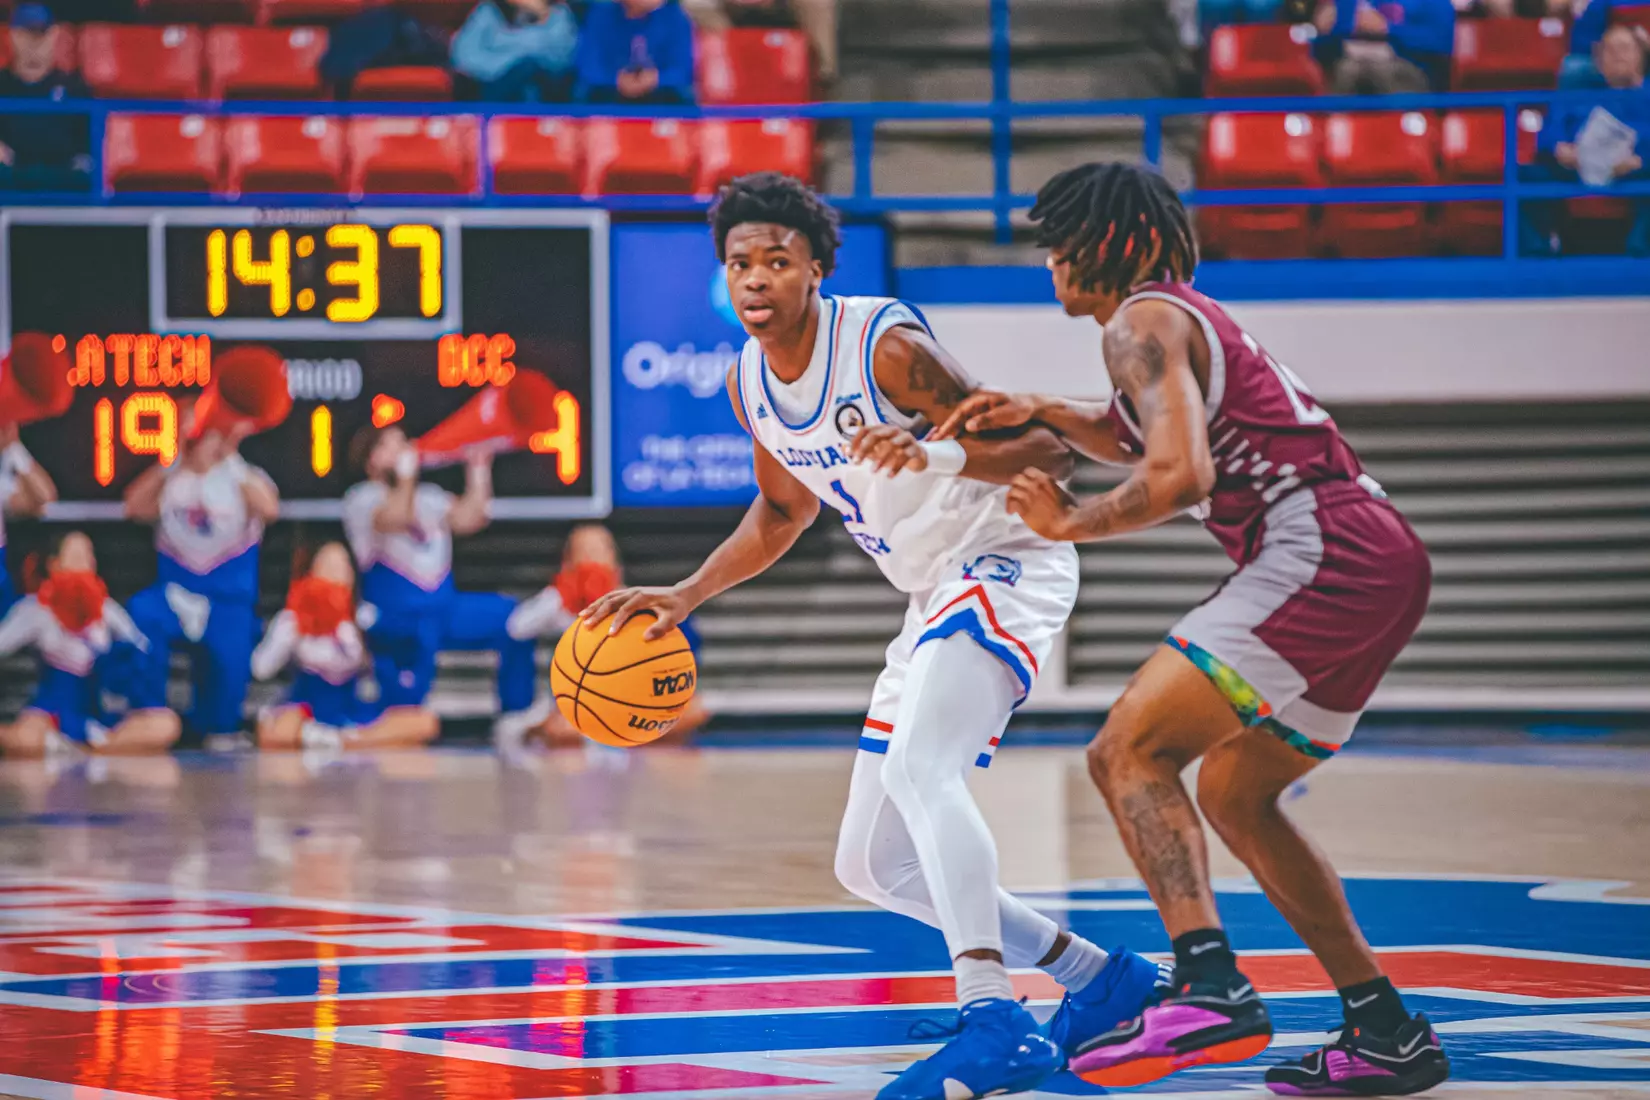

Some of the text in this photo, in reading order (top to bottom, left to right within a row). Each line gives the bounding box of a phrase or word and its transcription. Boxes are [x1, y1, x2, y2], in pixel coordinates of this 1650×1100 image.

[207, 224, 441, 321] 14:37
[94, 391, 178, 487] 19
[311, 405, 333, 478] 1
